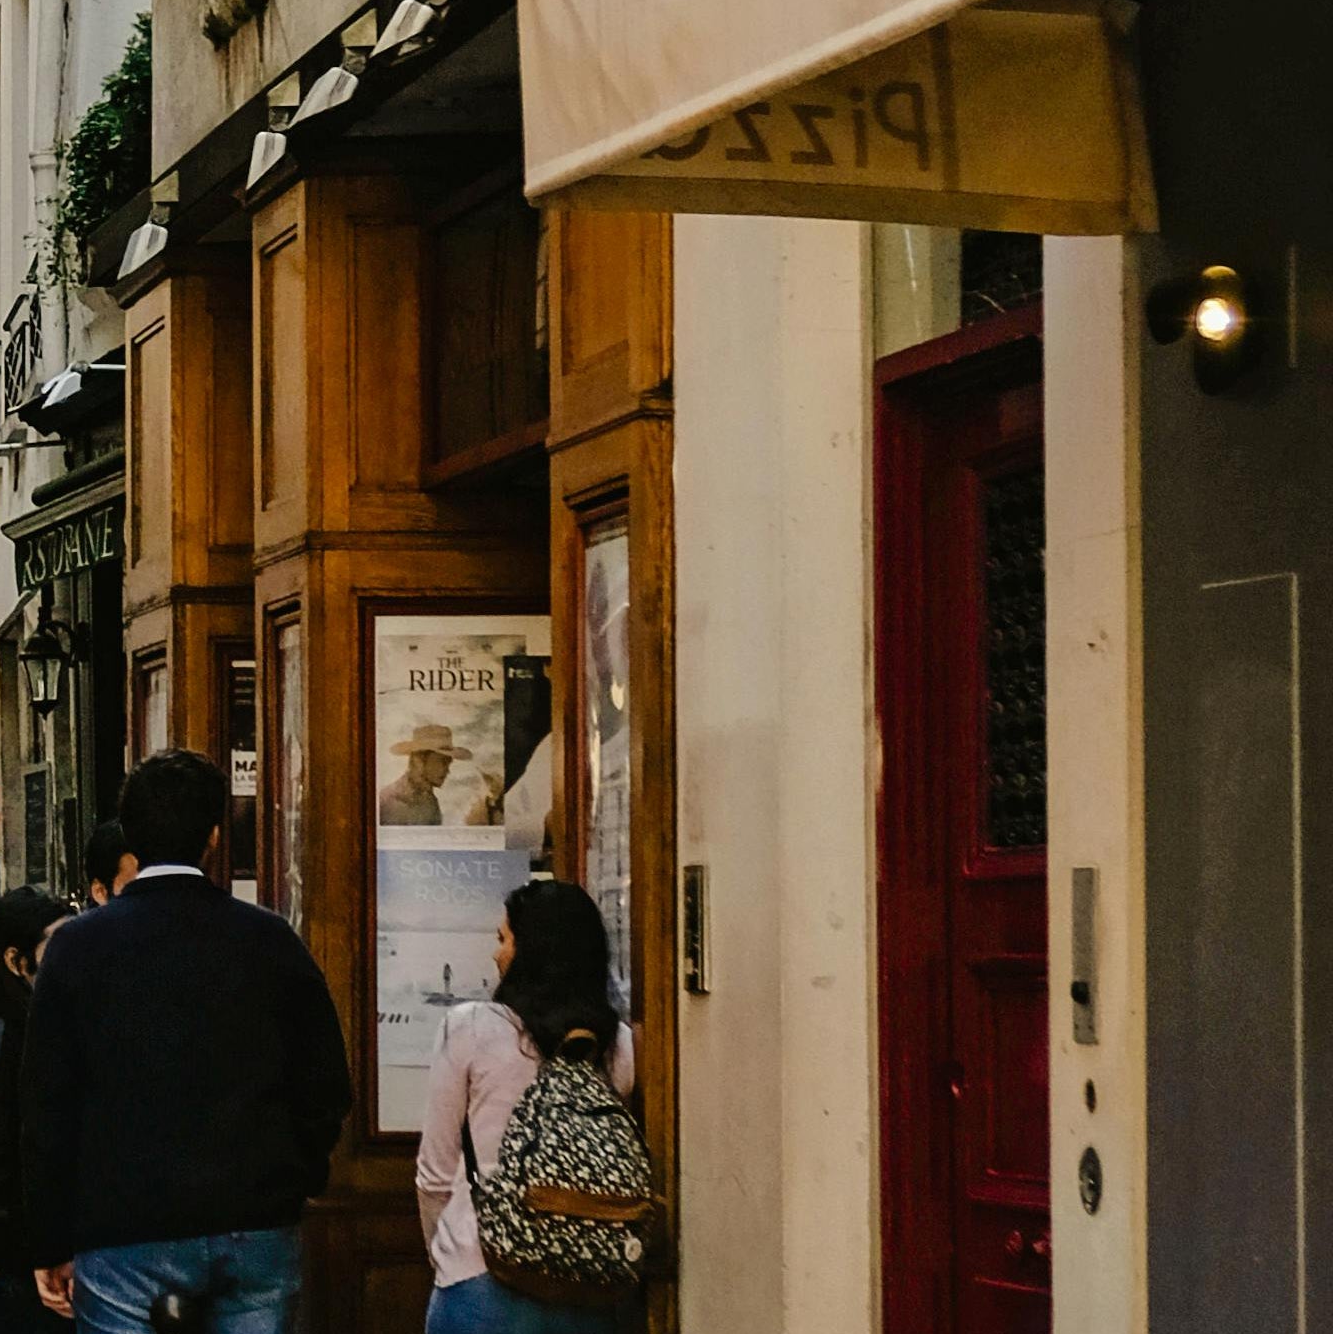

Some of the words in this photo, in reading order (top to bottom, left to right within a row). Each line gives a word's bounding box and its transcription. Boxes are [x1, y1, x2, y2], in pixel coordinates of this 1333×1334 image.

[437, 657, 465, 668] THE
[409, 669, 494, 692] RIDER
[399, 859, 502, 880] SONATE
